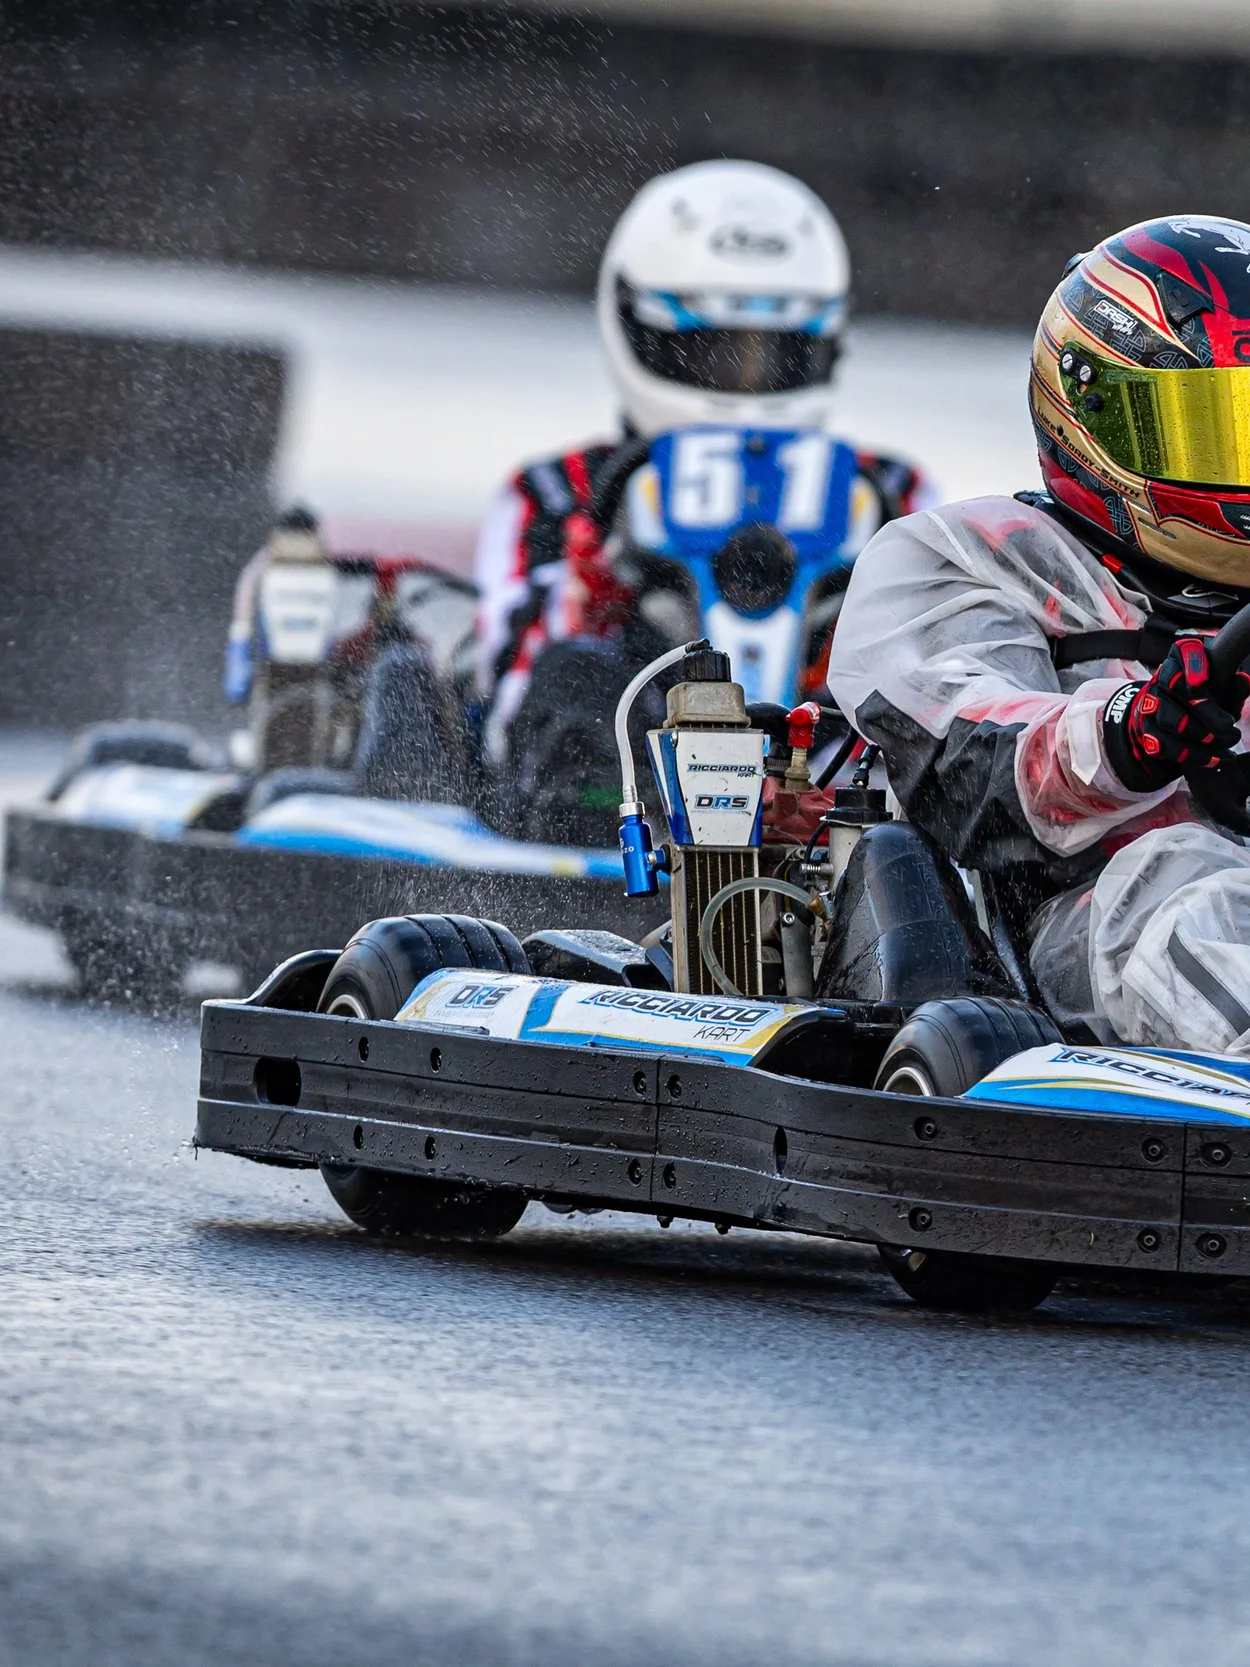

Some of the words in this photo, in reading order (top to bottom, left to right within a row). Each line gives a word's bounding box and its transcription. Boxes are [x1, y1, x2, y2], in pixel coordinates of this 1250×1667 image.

[670, 433, 834, 531] 51
[1110, 687, 1140, 724] OMP
[687, 763, 758, 773] RICCIARDO
[696, 795, 750, 808] DRS
[447, 983, 517, 1007] DRS
[583, 989, 774, 1024] RICCIARDO
[693, 1025, 751, 1042] KART
